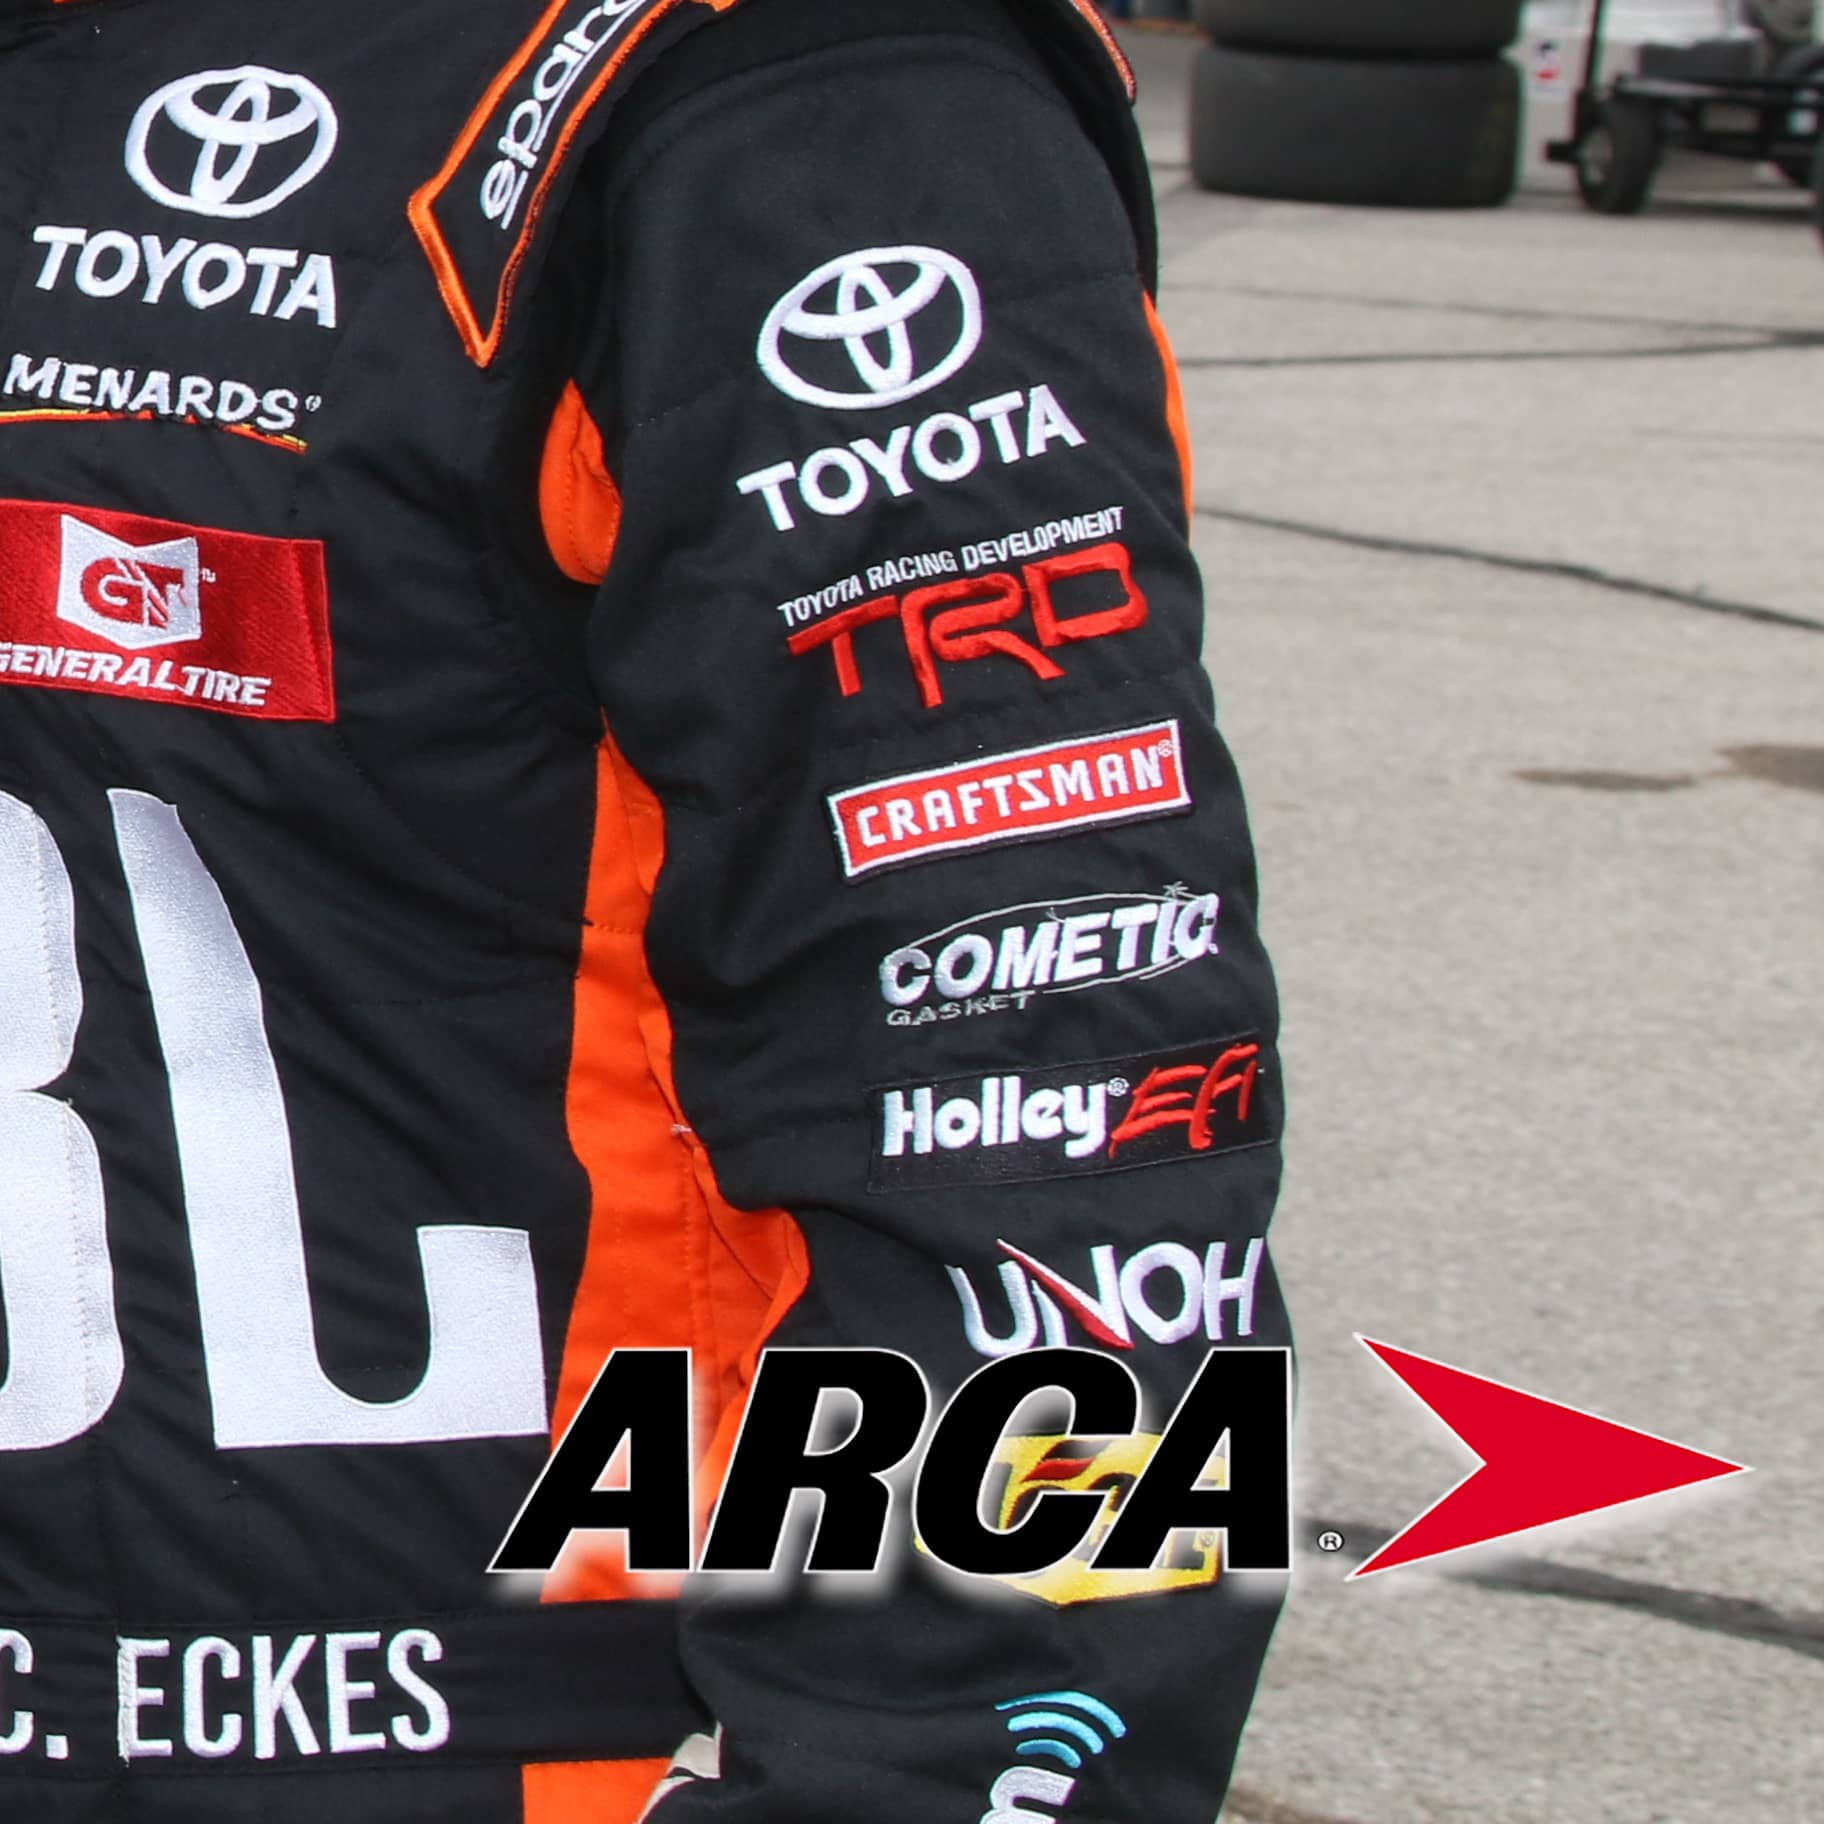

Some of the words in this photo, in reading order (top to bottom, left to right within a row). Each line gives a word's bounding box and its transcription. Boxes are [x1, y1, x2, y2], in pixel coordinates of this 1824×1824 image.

[33, 225, 337, 328] TOYOTA
[2, 353, 298, 433] MENARDS
[736, 383, 1088, 531] TOYOTA
[777, 579, 864, 627] TOYOTA
[865, 550, 959, 590] RACING
[961, 505, 1124, 572] DEVELOPMENT
[786, 541, 1149, 709] TRD
[855, 744, 1165, 847] CRAFTSMAN
[878, 892, 1220, 1007] COMETIC
[886, 991, 1037, 1026] GASKET
[881, 1075, 1110, 1159] Holley
[944, 1237, 1265, 1358] UNOH
[116, 1628, 452, 1760] ECKES
